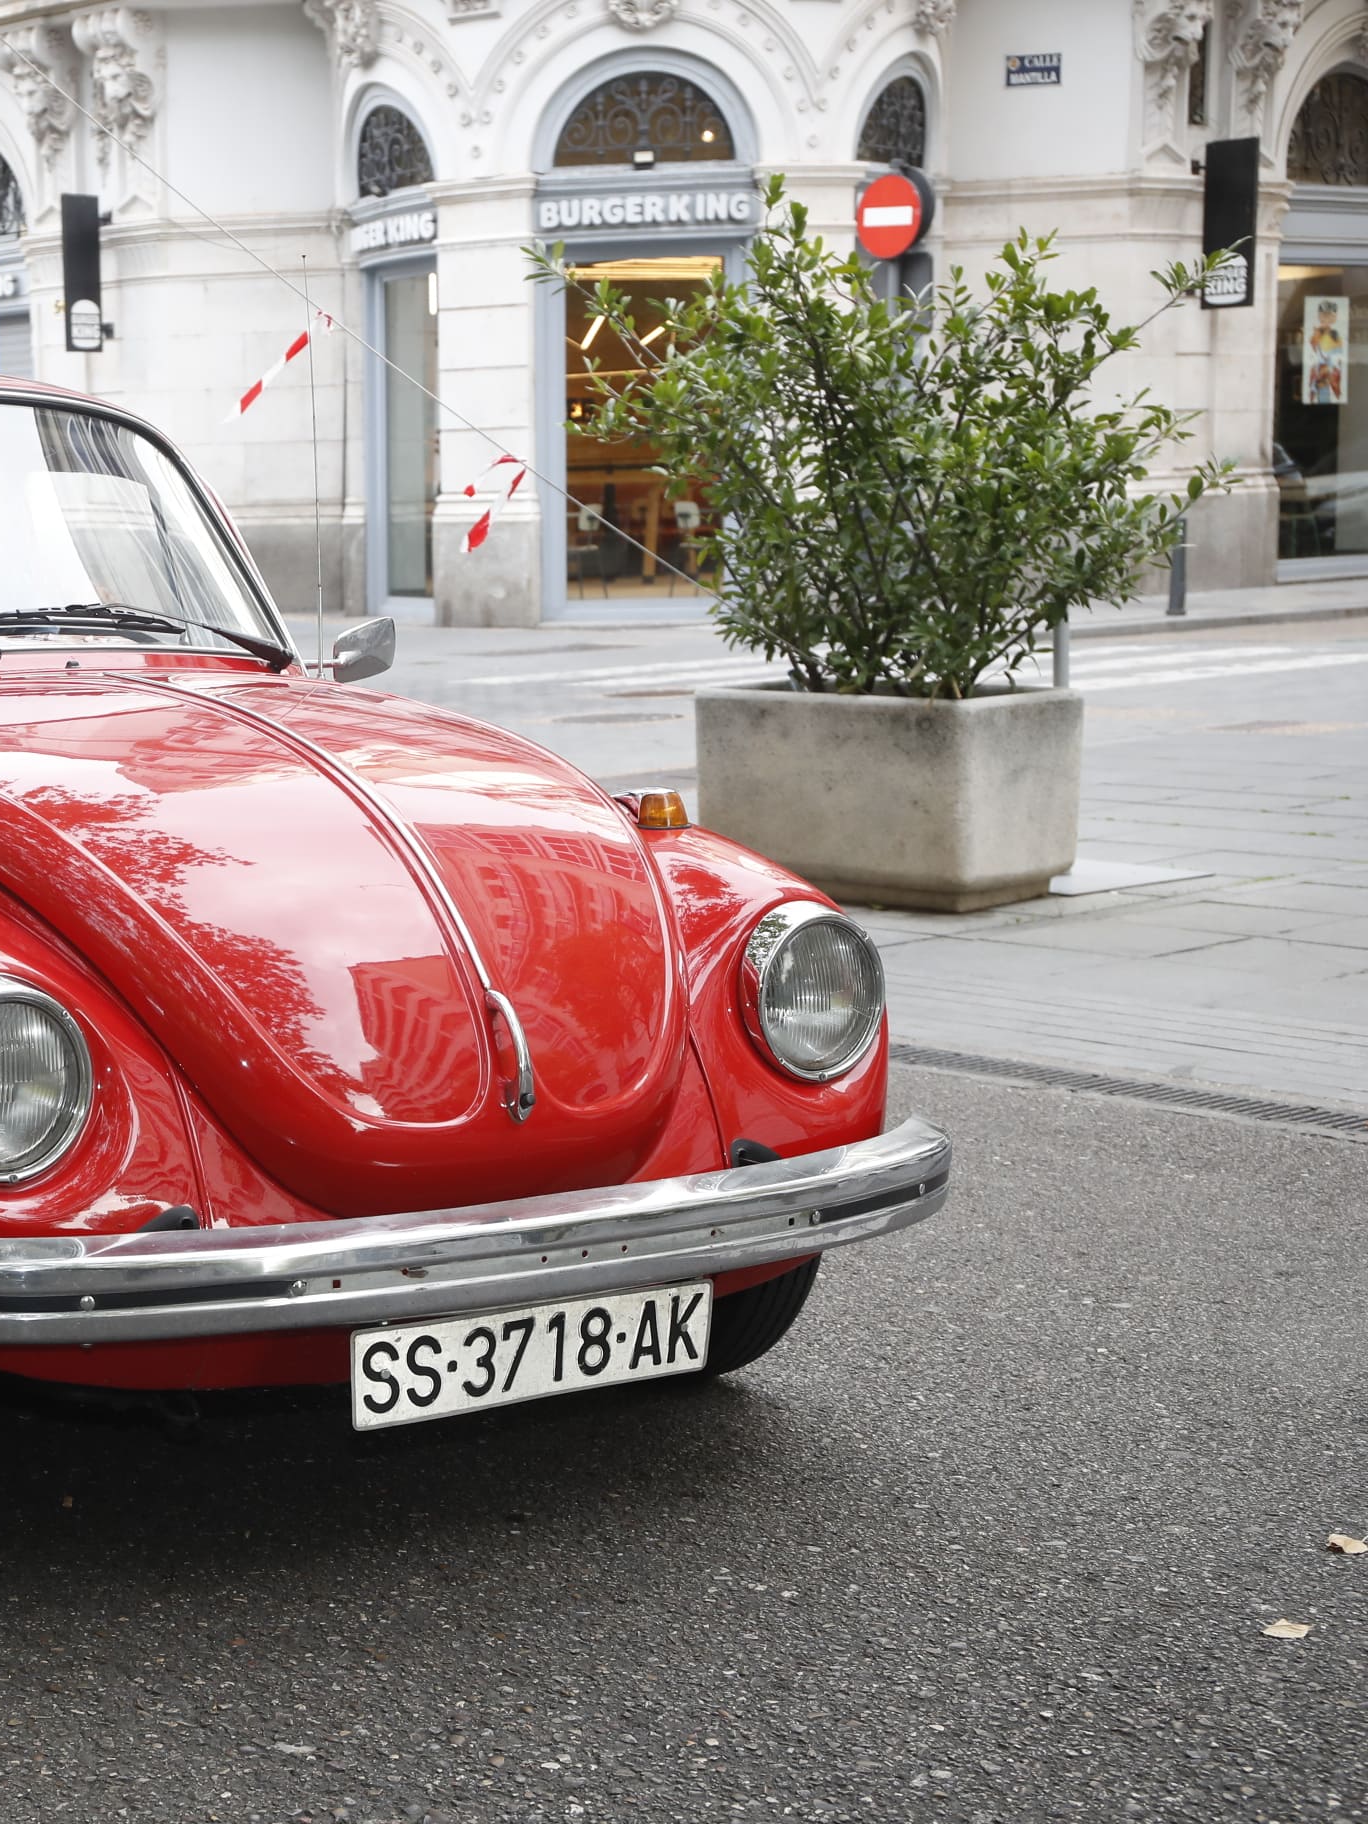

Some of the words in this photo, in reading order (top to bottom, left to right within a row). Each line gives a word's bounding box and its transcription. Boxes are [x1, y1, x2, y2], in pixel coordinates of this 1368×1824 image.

[539, 195, 665, 229] BURGER
[668, 192, 751, 222] KING
[387, 212, 435, 244] KING
